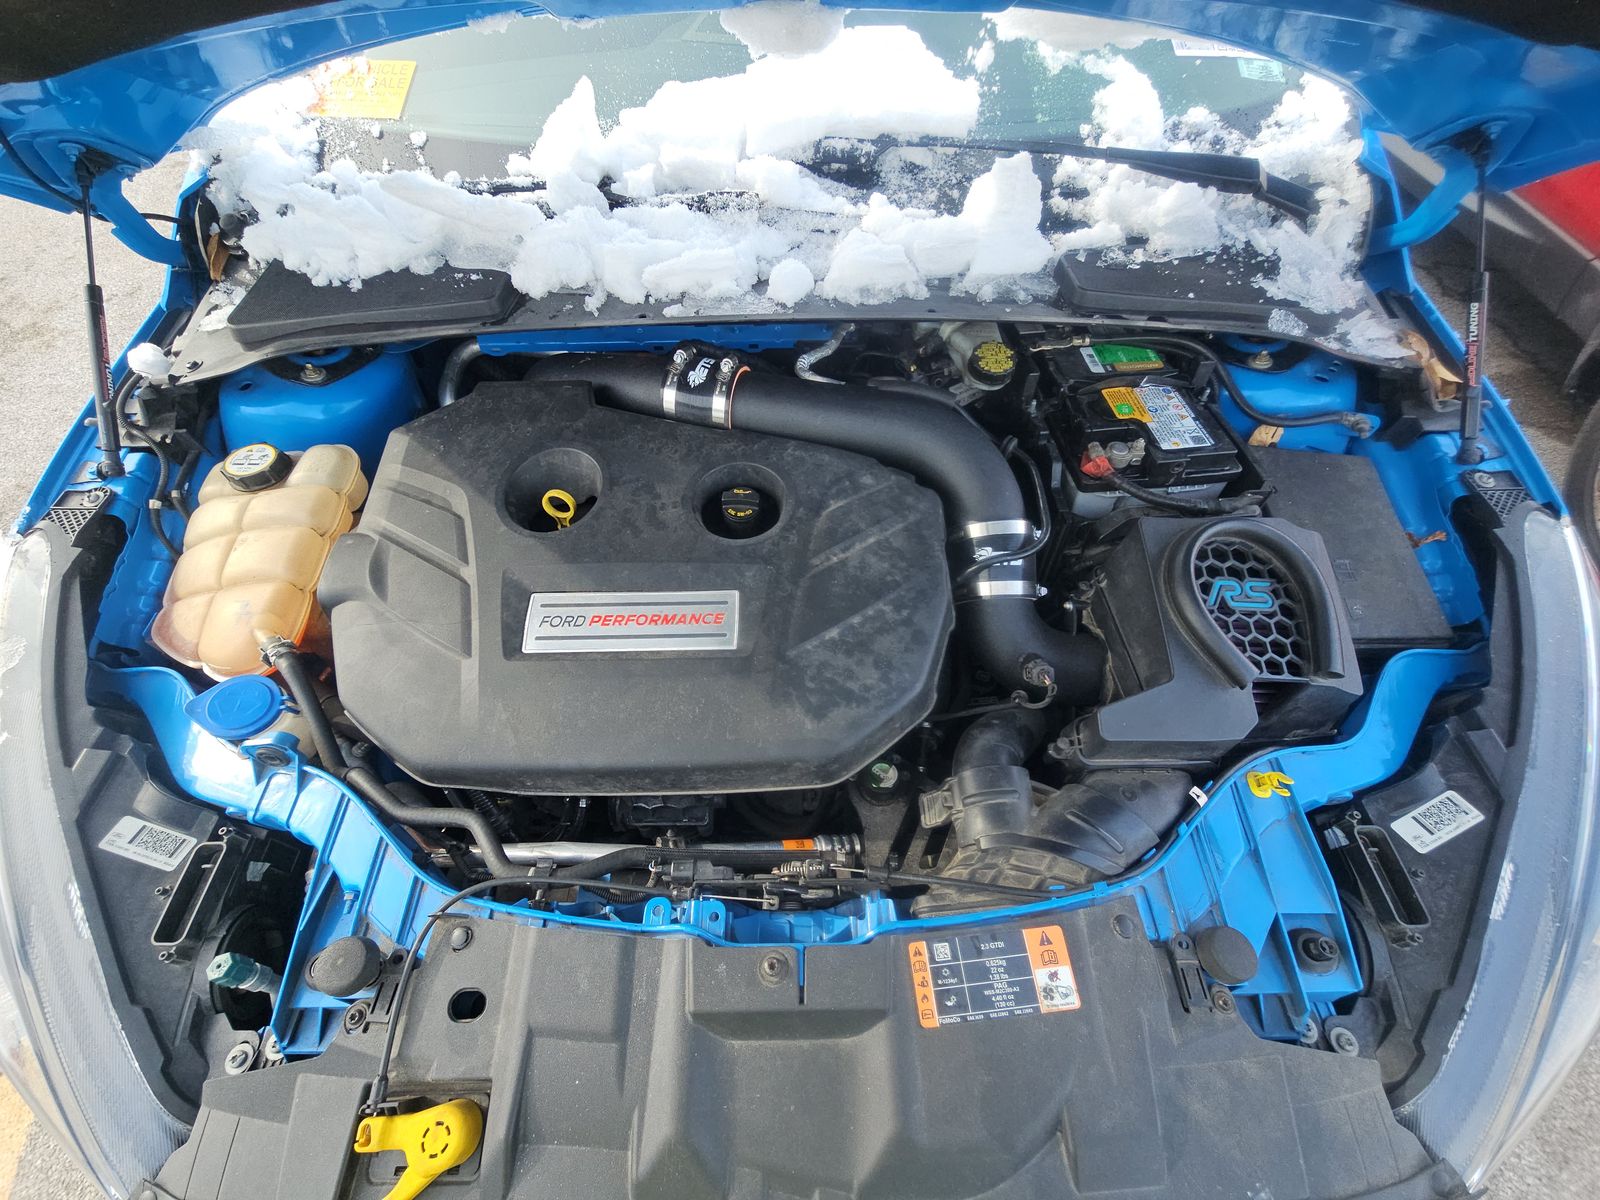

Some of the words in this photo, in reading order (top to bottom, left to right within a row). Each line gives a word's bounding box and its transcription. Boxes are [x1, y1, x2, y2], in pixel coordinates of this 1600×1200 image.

[1469, 302, 1480, 342] TUNING
[1208, 578, 1274, 610] RS
[538, 614, 587, 628] FORD
[587, 612, 726, 627] PERFORMANCE
[980, 943, 989, 951] 2.3
[993, 981, 1008, 989] PAG
[939, 1016, 961, 1025] FoMoCo
